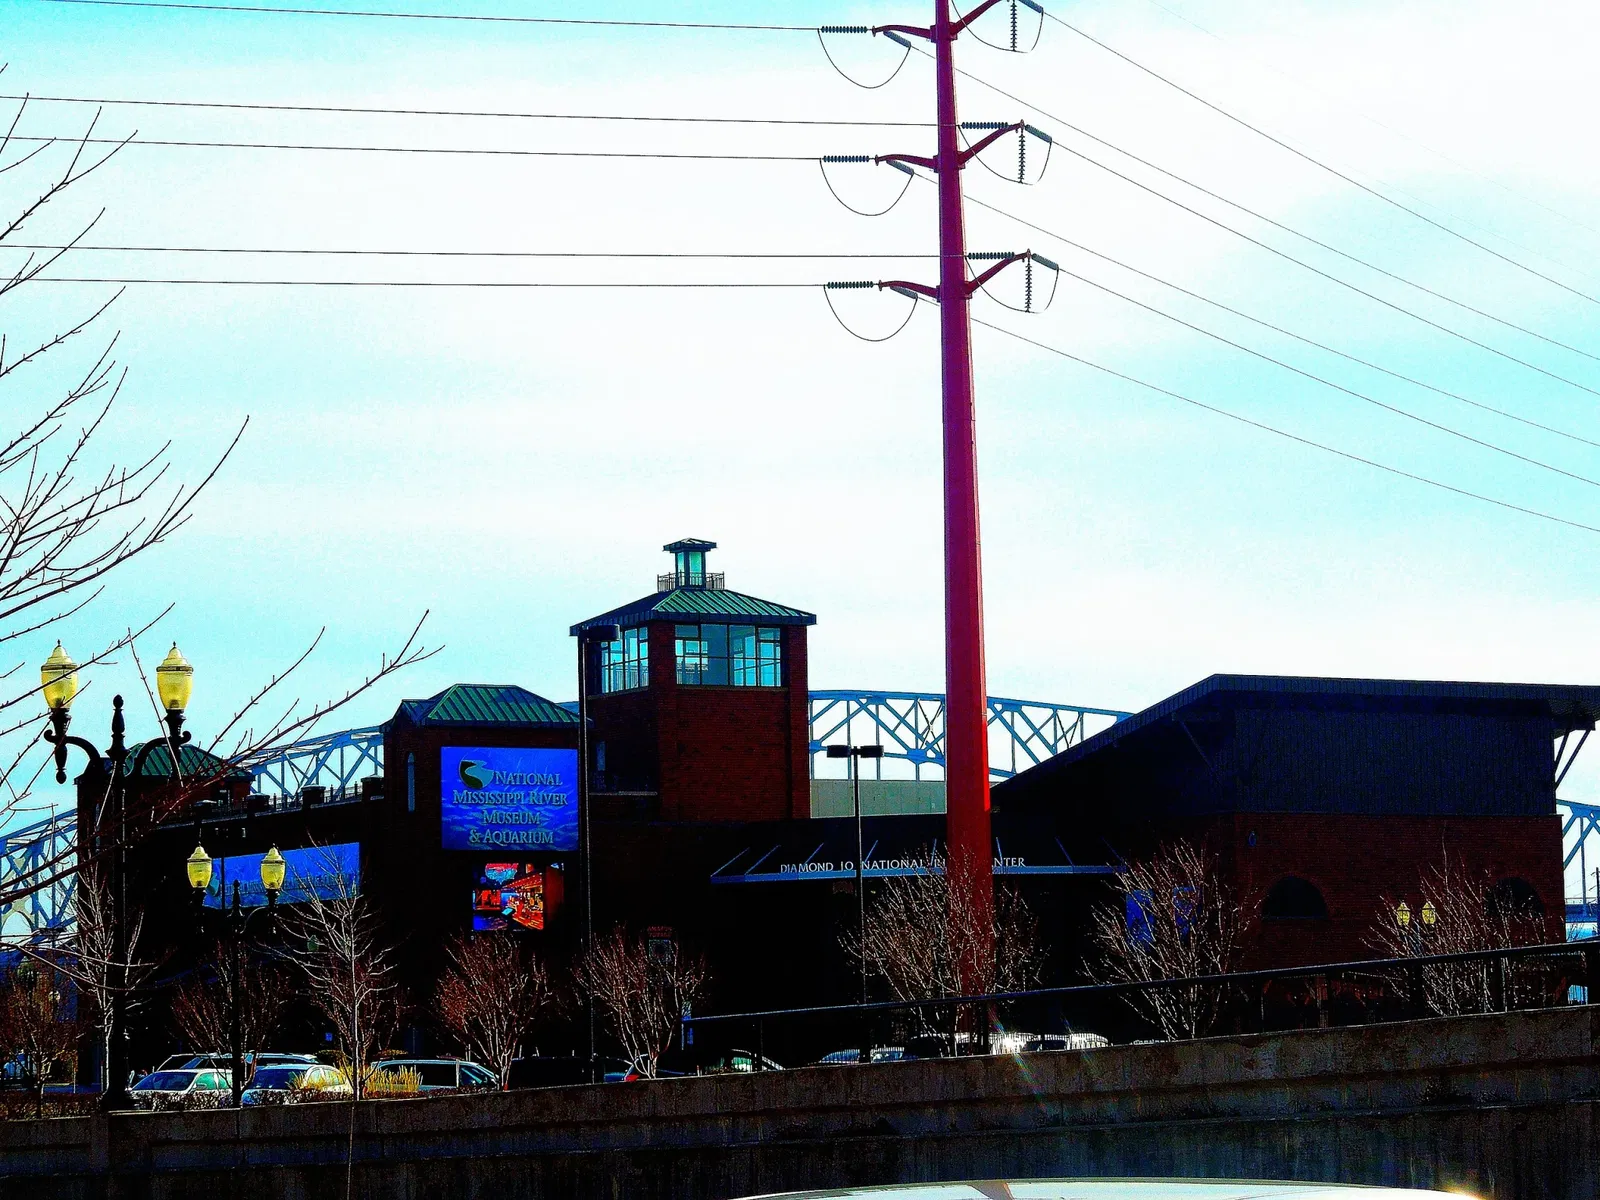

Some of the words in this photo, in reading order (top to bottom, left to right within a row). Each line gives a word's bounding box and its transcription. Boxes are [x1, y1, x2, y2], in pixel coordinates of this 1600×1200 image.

[495, 771, 563, 786] NATIONAL
[453, 789, 525, 806] MISSISSIPPI
[528, 791, 568, 805] RIVER
[482, 809, 541, 825] MUSEUM
[469, 829, 480, 844] &
[484, 828, 554, 846] AQUARIUM
[780, 862, 834, 874] DIAMOND
[840, 861, 854, 872] JO
[861, 858, 924, 871] NATIONAL
[993, 857, 1026, 868] NTER
